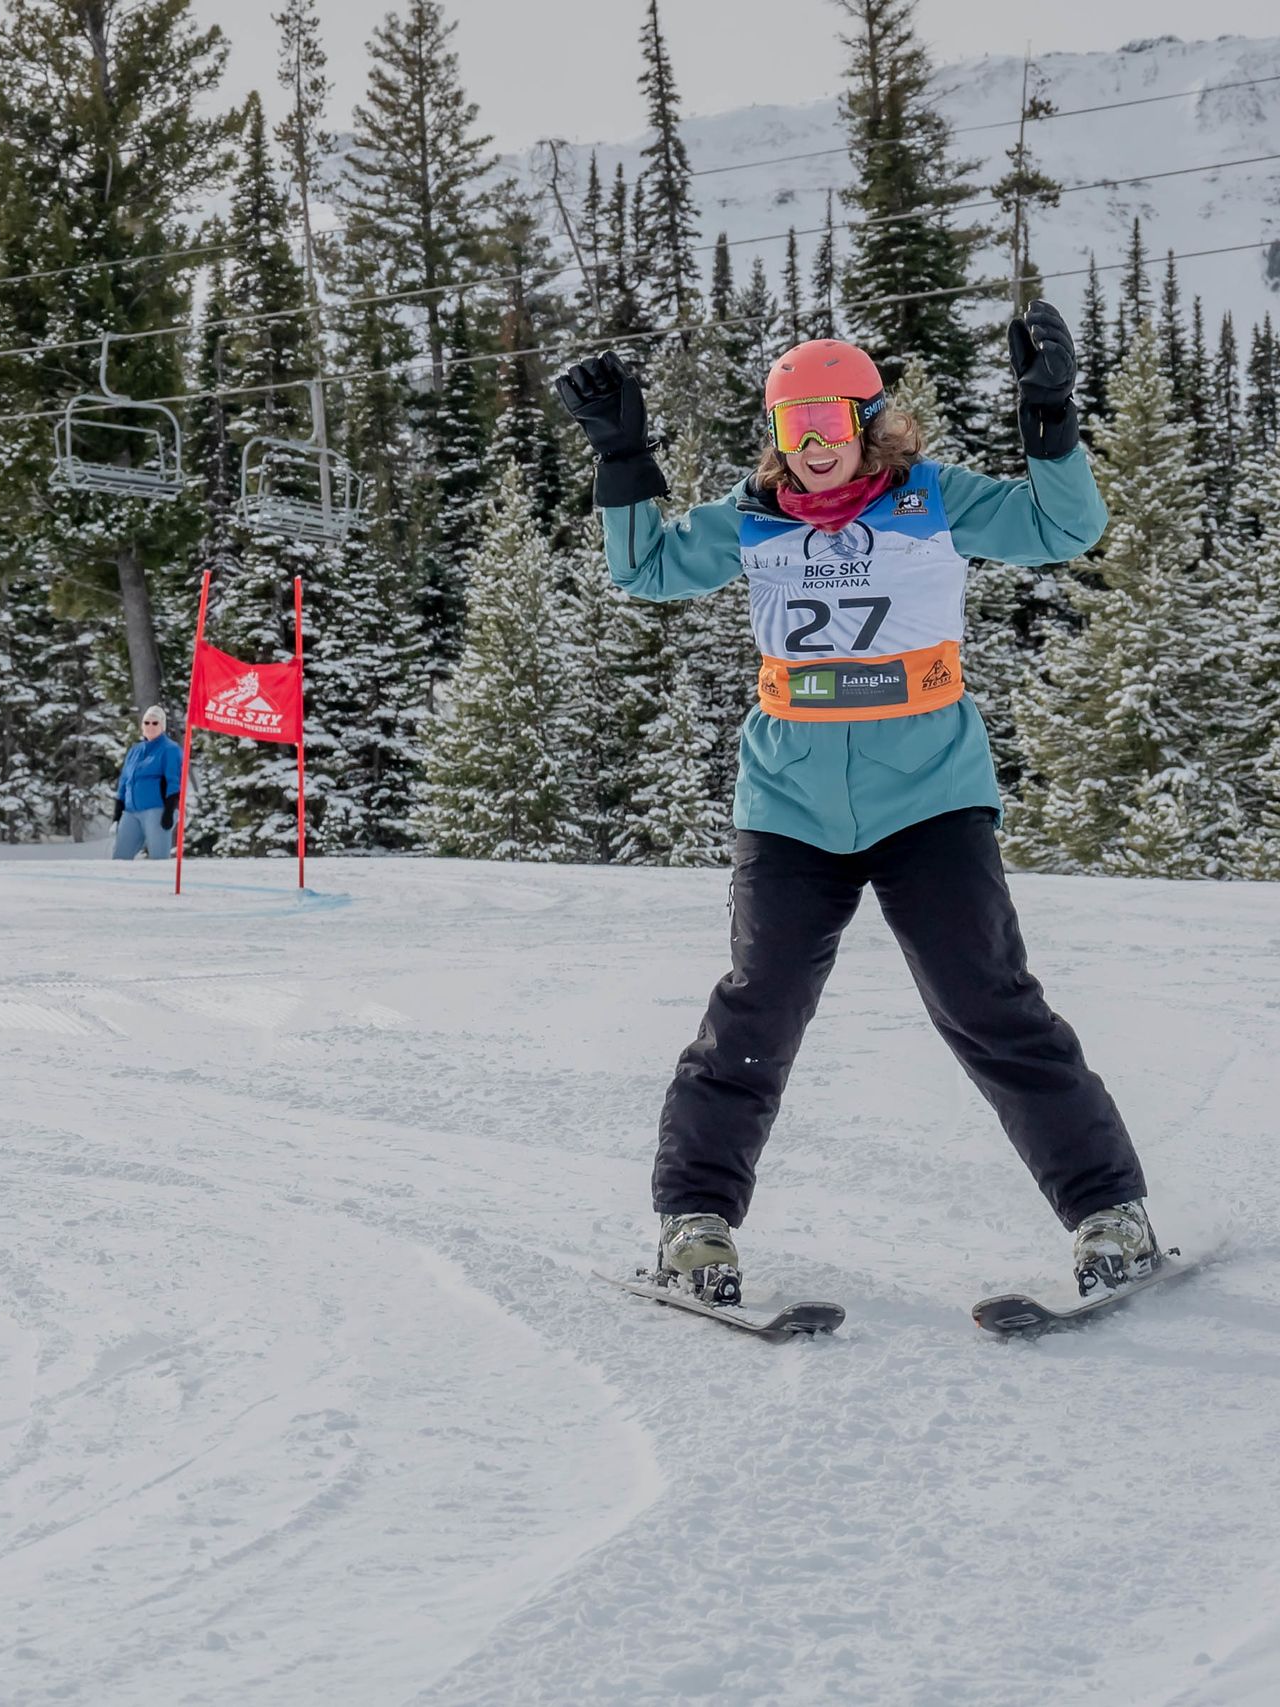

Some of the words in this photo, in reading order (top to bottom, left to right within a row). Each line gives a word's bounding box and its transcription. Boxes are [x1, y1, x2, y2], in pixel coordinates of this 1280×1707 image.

[804, 564, 835, 577] BIG
[839, 560, 872, 575] SKY
[802, 578, 870, 589] MONTANA
[784, 596, 892, 653] 27
[841, 673, 900, 687] Langlas
[205, 699, 238, 718] BIG
[242, 711, 283, 726] SKY
